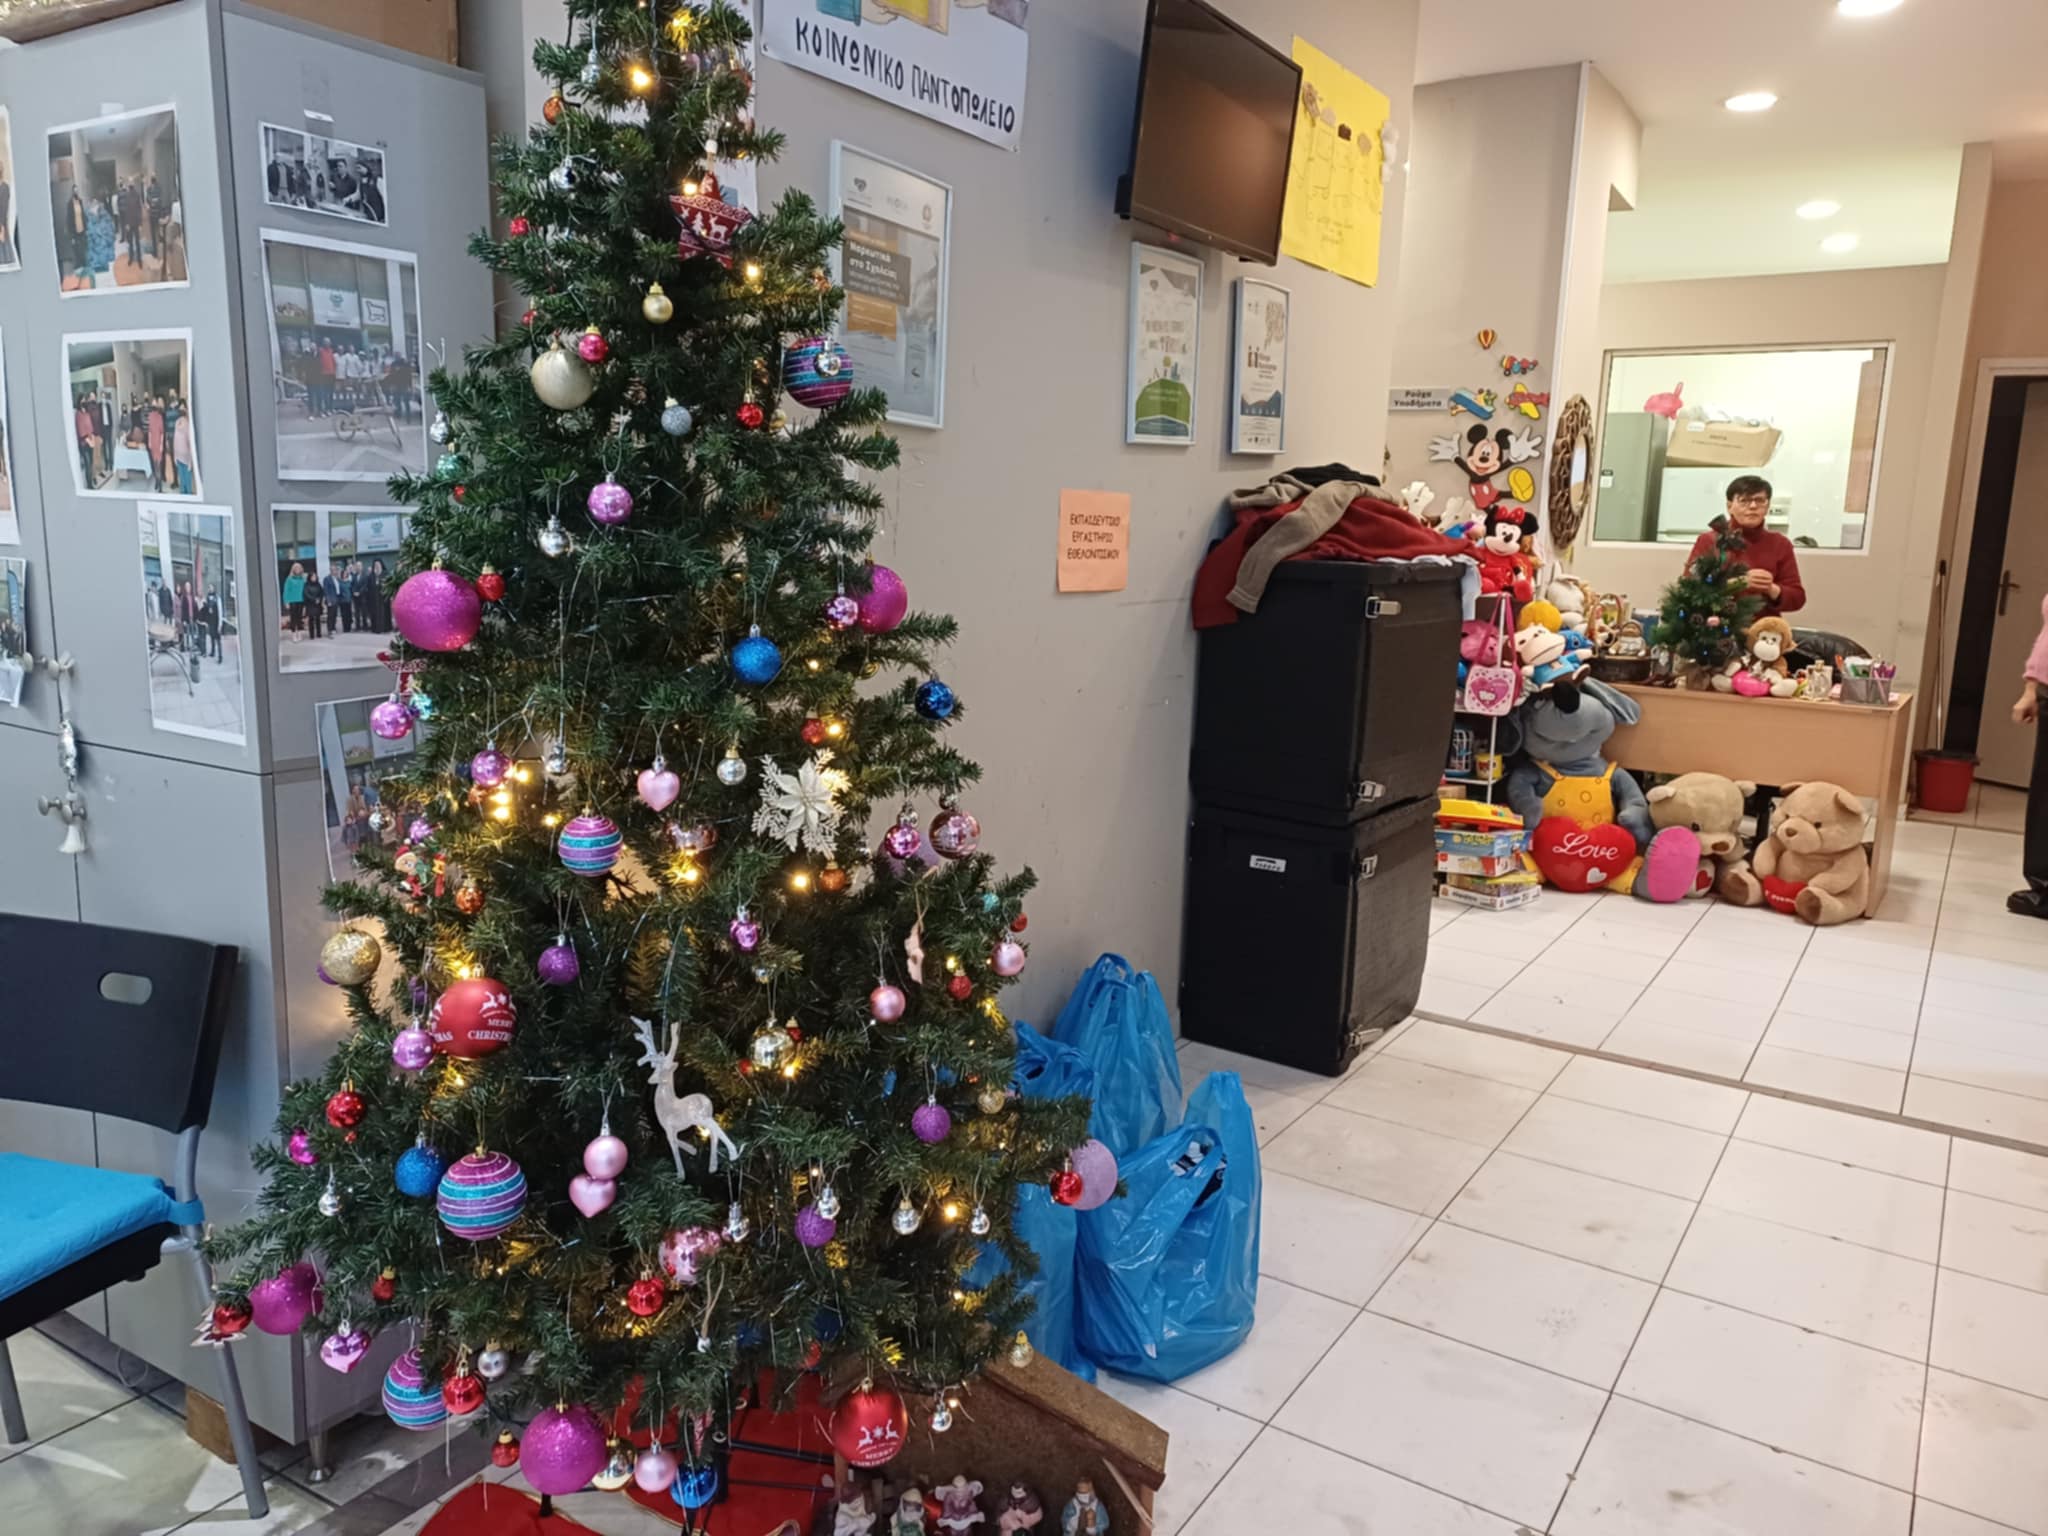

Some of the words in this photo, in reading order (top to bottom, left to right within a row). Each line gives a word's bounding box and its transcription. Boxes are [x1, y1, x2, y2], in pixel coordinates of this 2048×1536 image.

[796, 17, 904, 90] ΚΟΙΝΩΝΙΚΟ
[911, 64, 1015, 133] ΠΑΝΤΟΠΩΛΕΙΟ
[1552, 832, 1619, 861] Love
